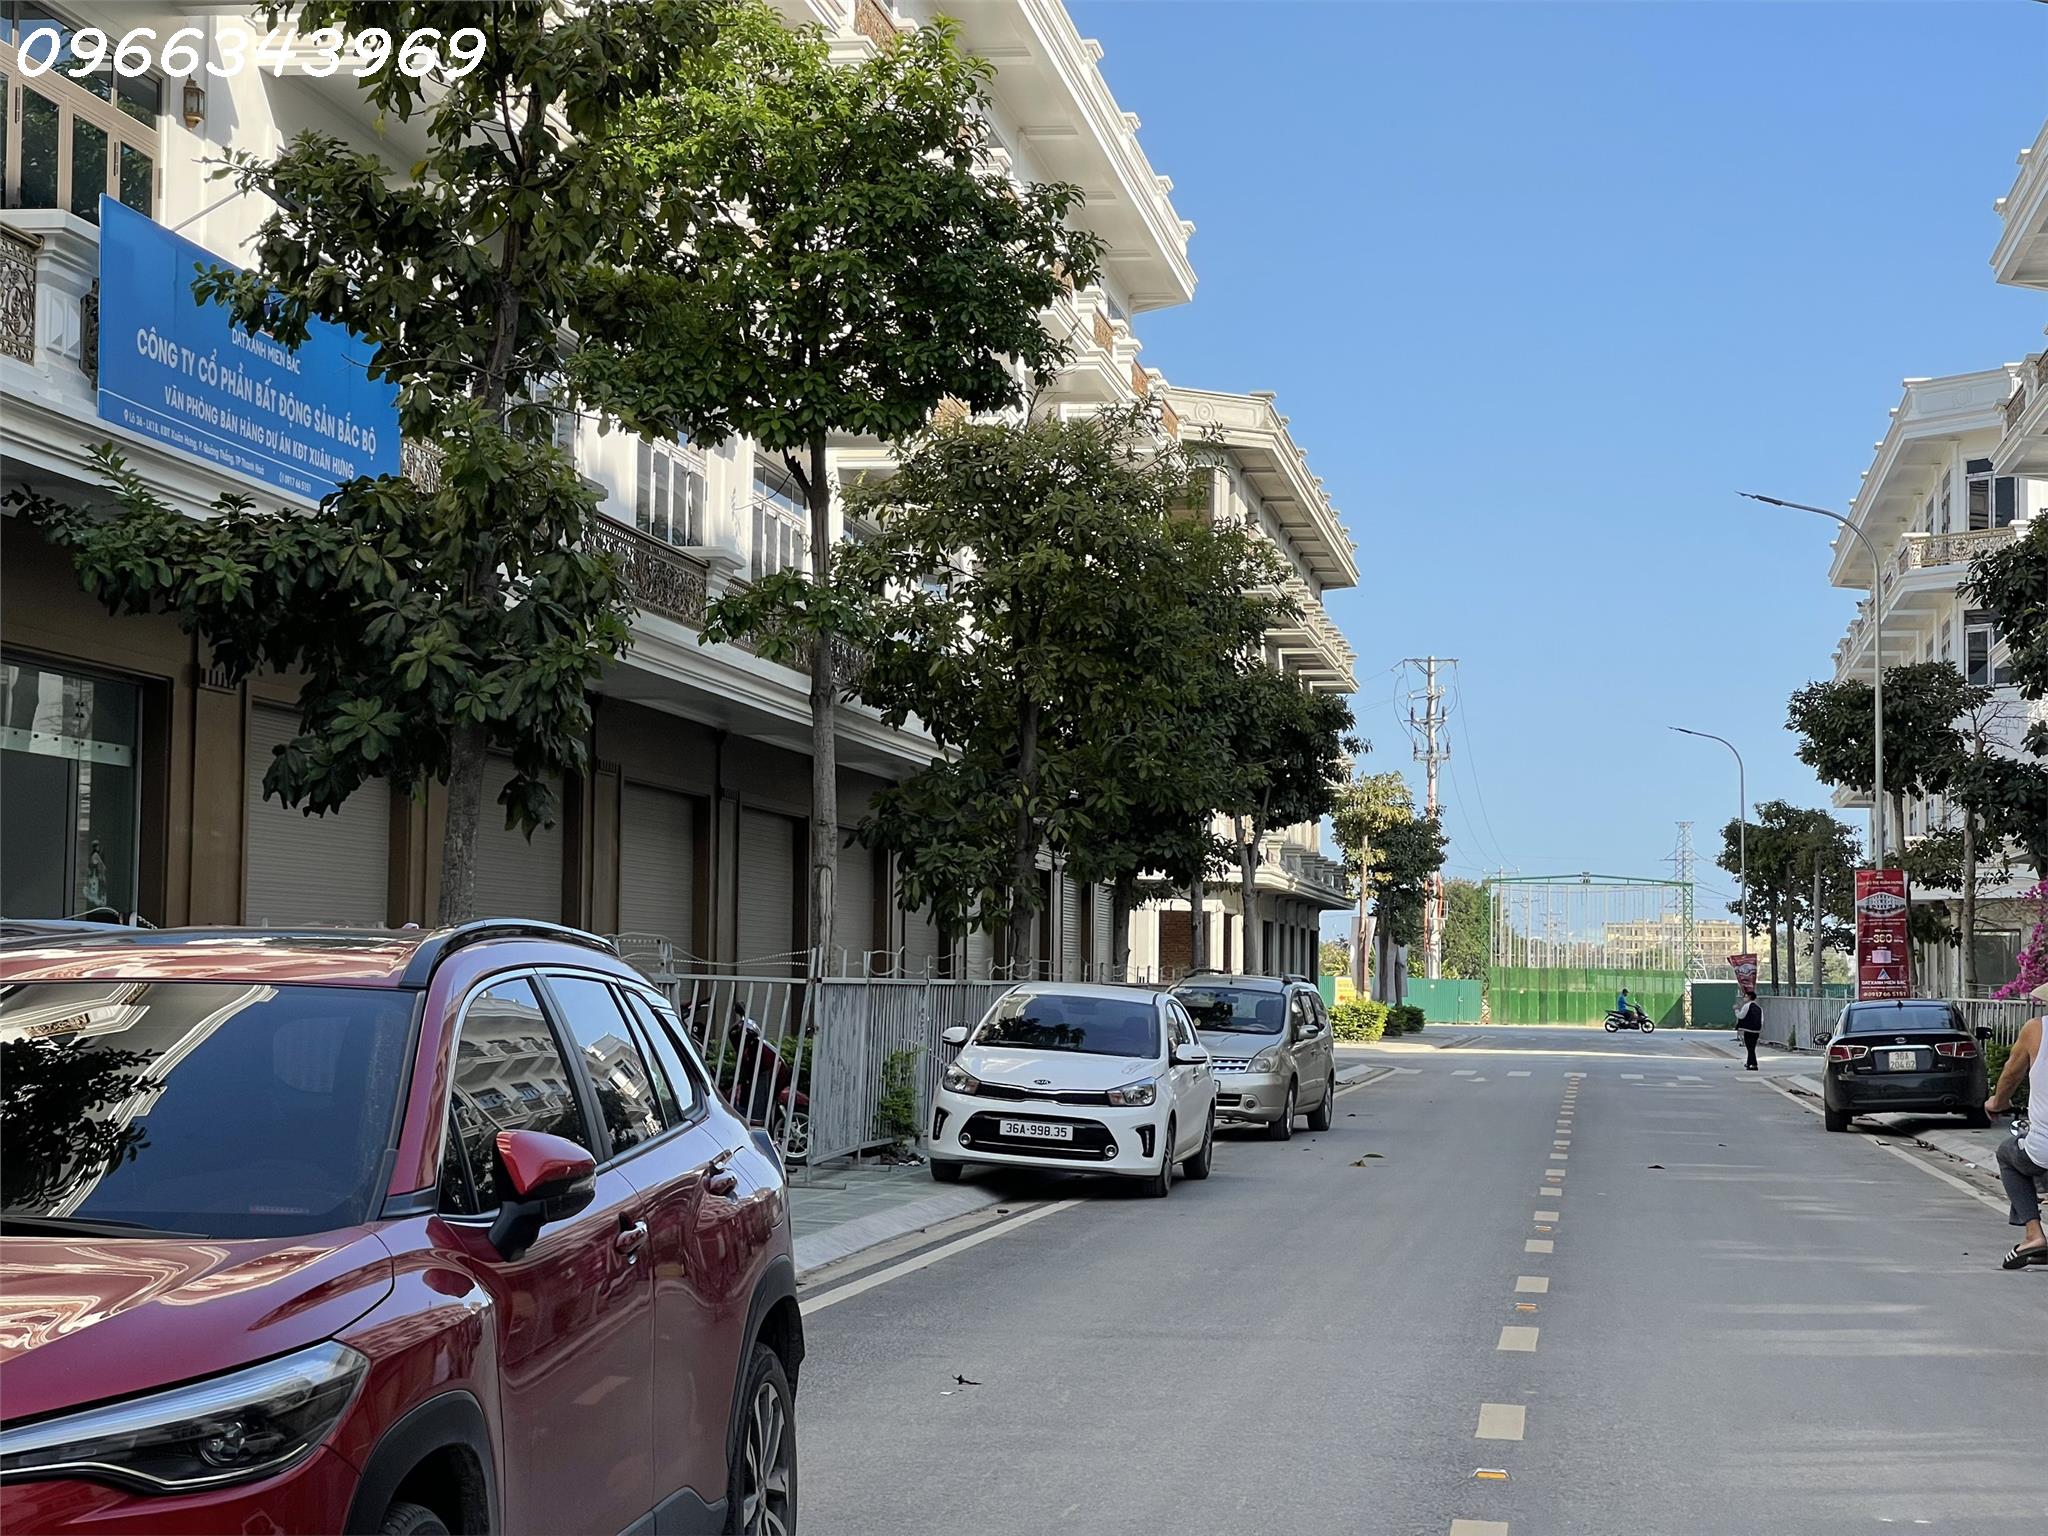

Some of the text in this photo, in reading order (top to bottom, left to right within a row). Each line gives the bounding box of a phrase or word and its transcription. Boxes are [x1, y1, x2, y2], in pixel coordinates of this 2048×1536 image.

[137, 326, 178, 368] CÔNG
[181, 347, 195, 376] TY
[198, 348, 217, 386] CỔ
[255, 377, 276, 413] BẤT
[279, 391, 312, 428] ĐỘNG
[314, 403, 335, 438] SẢN
[337, 411, 360, 448] BẮC
[361, 426, 376, 461] BỘ
[186, 396, 218, 425] PHÒNG
[220, 408, 238, 434] BÁN
[240, 416, 264, 444] HÀNG
[266, 430, 278, 454] DỰ
[279, 431, 292, 455] ÁN
[293, 440, 308, 462] KĐT
[309, 447, 331, 472] XUÂN
[332, 456, 354, 479] HƯNG
